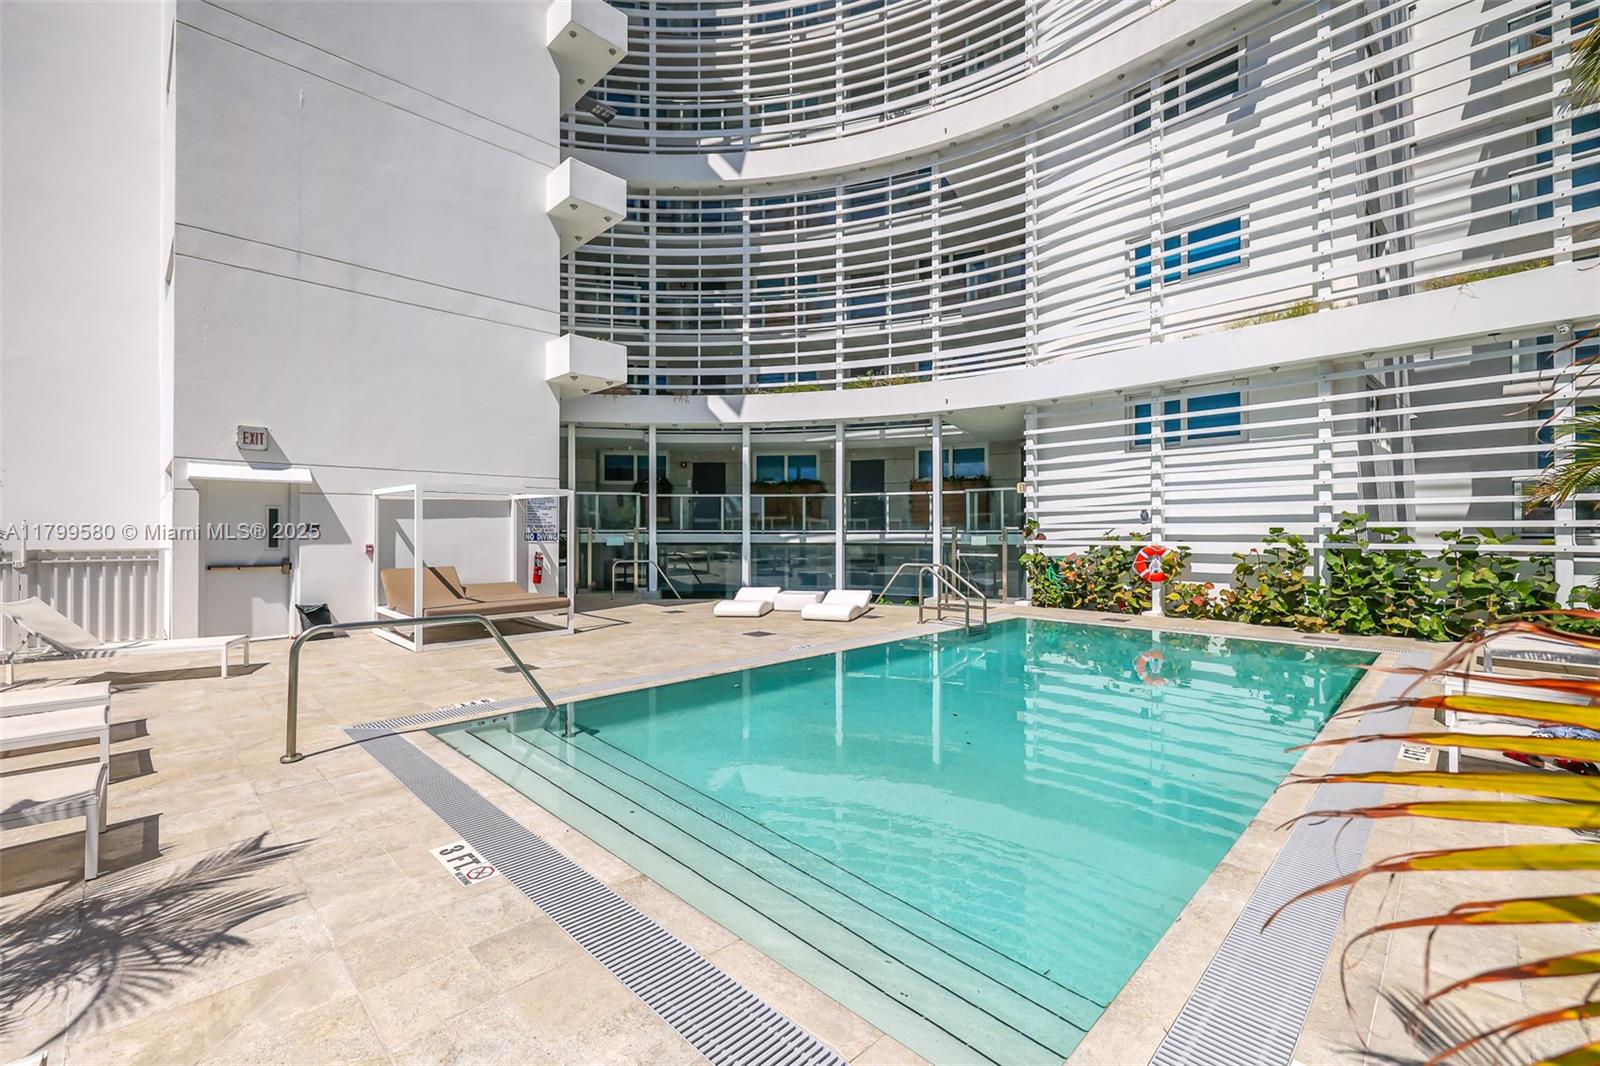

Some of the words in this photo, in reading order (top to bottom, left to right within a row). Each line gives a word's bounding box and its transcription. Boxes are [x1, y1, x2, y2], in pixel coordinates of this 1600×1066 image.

[243, 431, 265, 446] EXIT
[525, 533, 535, 541] NO
[536, 533, 558, 541] DIVING
[439, 845, 465, 856] 3
